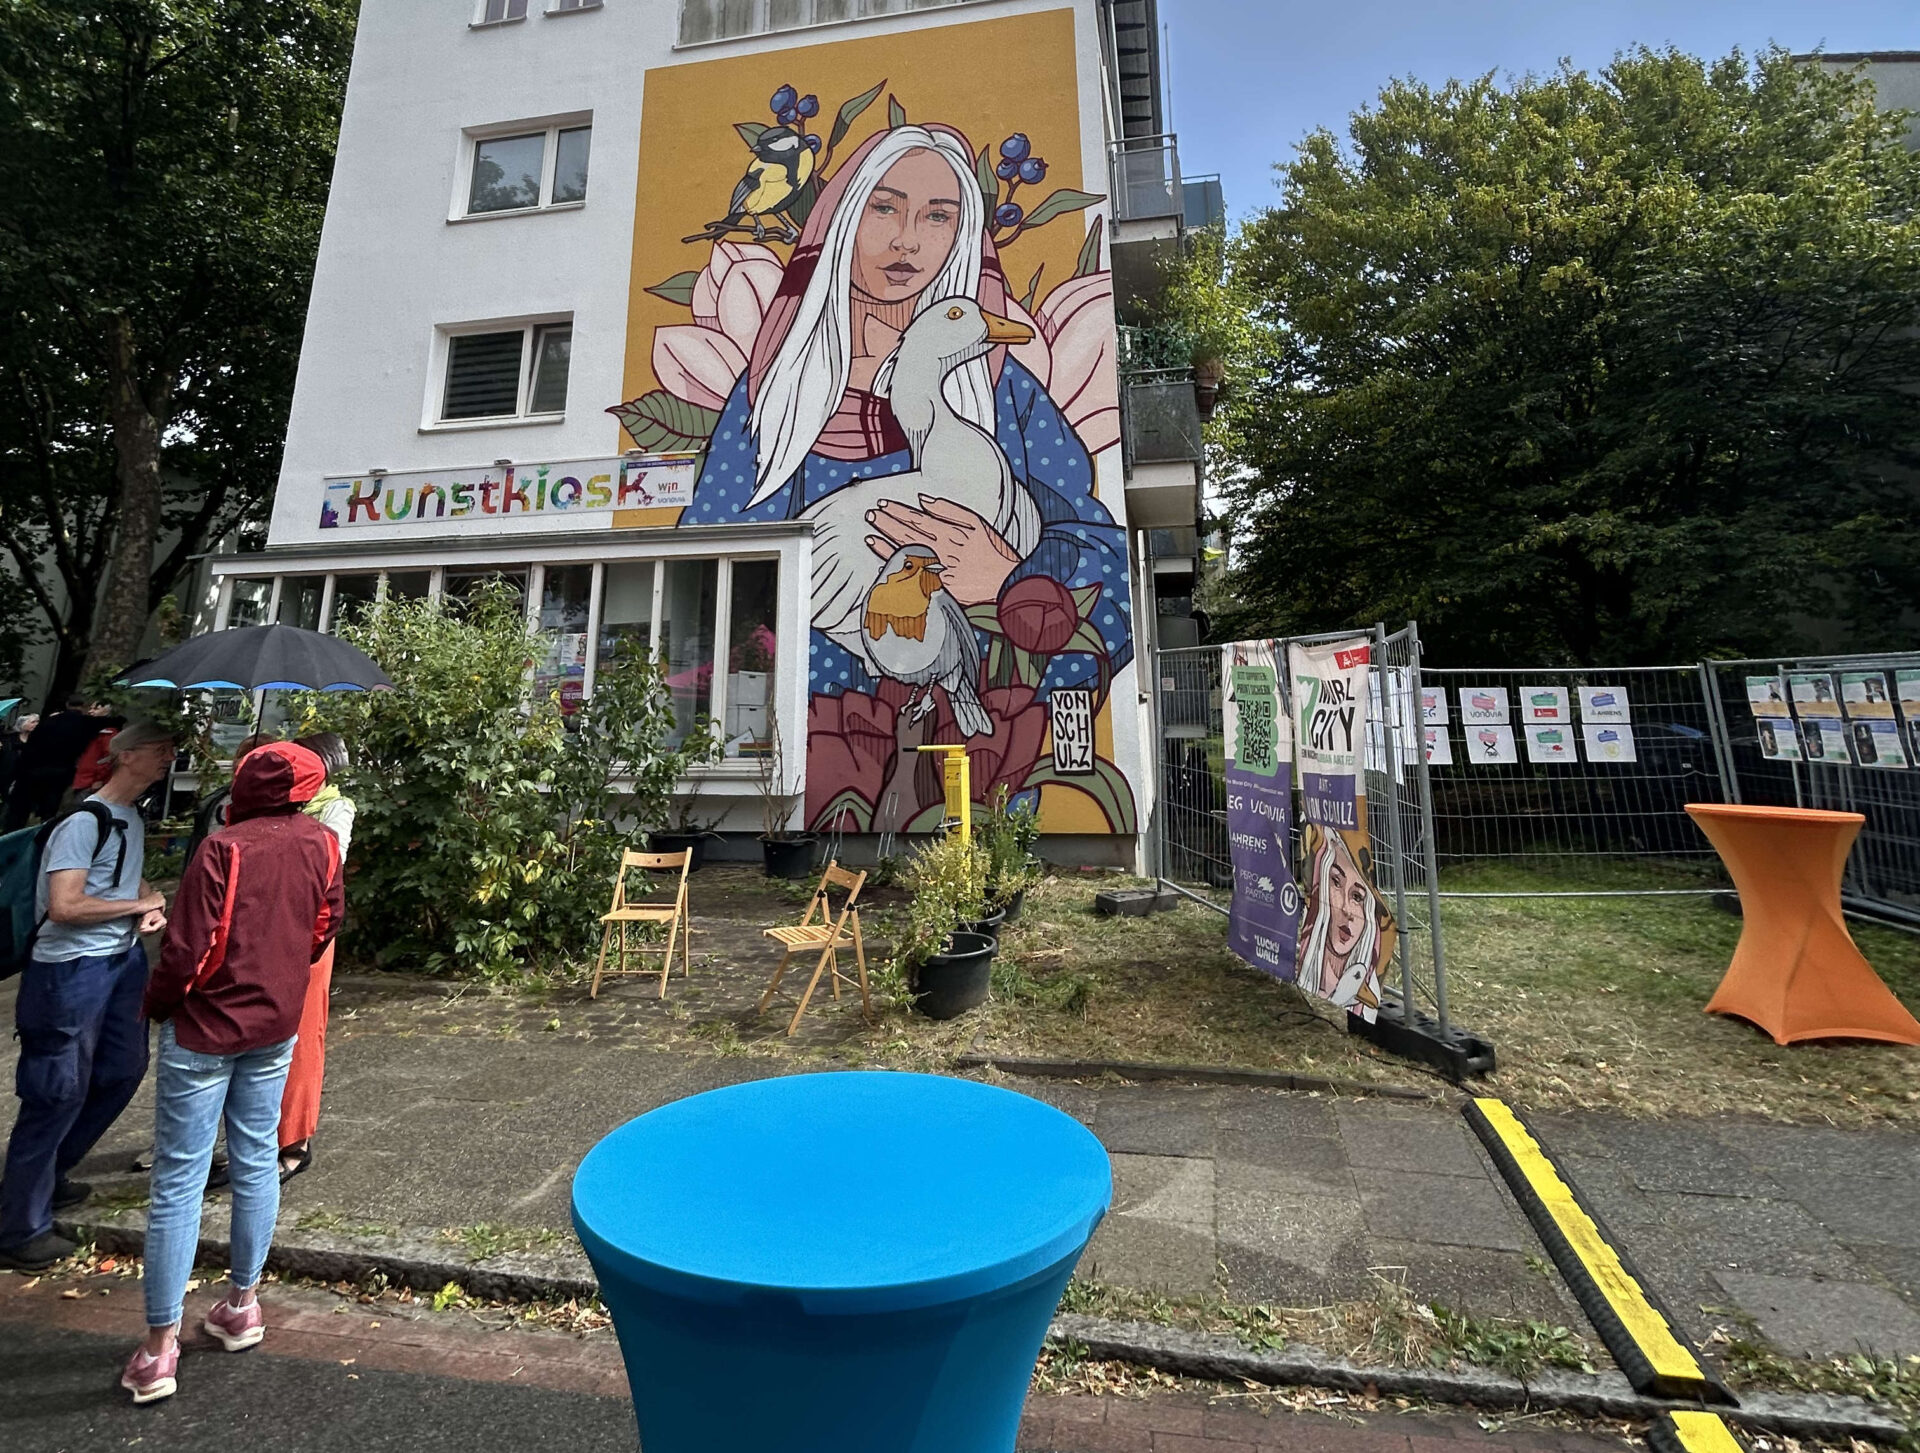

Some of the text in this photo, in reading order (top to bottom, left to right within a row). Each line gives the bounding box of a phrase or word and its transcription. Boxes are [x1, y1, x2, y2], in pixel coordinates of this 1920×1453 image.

[1053, 692, 1086, 710] VON
[1055, 710, 1090, 743] SCH
[1056, 742, 1091, 768] ULZ
[1232, 832, 1267, 850] AHRENS
[1246, 887, 1275, 904] PARTNER
[1256, 946, 1279, 965] WALLS
